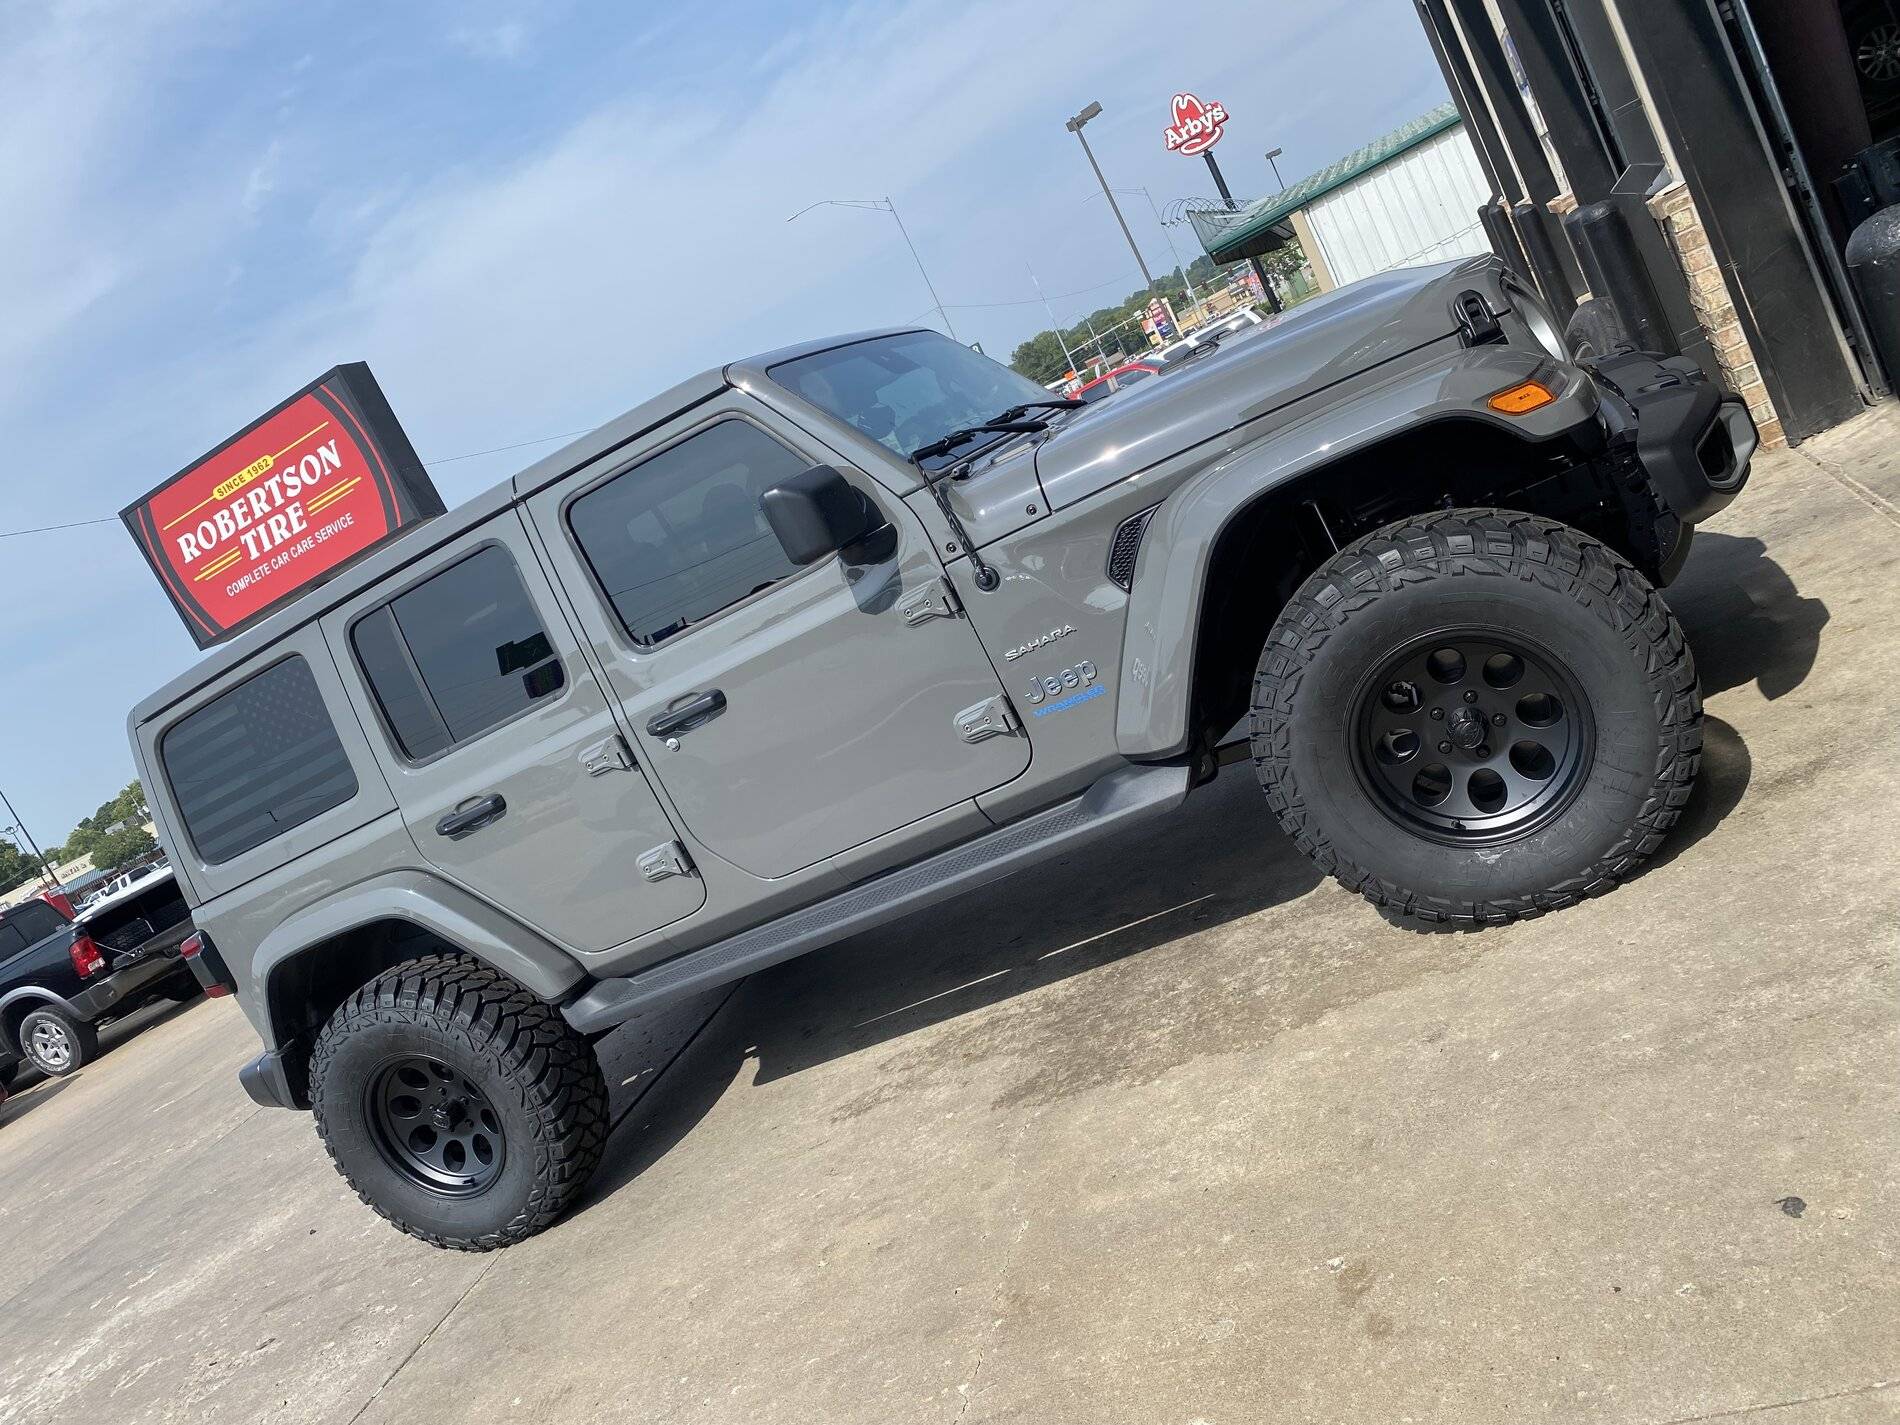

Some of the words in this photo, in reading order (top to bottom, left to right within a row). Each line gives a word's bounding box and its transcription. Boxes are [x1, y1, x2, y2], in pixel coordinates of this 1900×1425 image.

[1164, 104, 1226, 149] Arby's
[176, 438, 342, 563] ROBERTSON
[216, 474, 246, 498] SINCE
[247, 458, 270, 478] 1962
[240, 501, 308, 561] TIRE
[226, 564, 271, 597] COMPLETE
[271, 552, 291, 571] CAR
[290, 537, 316, 558] CARE
[315, 512, 354, 545] SERVICE
[1005, 624, 1077, 662] SAHARA
[1025, 660, 1097, 704] Jeep
